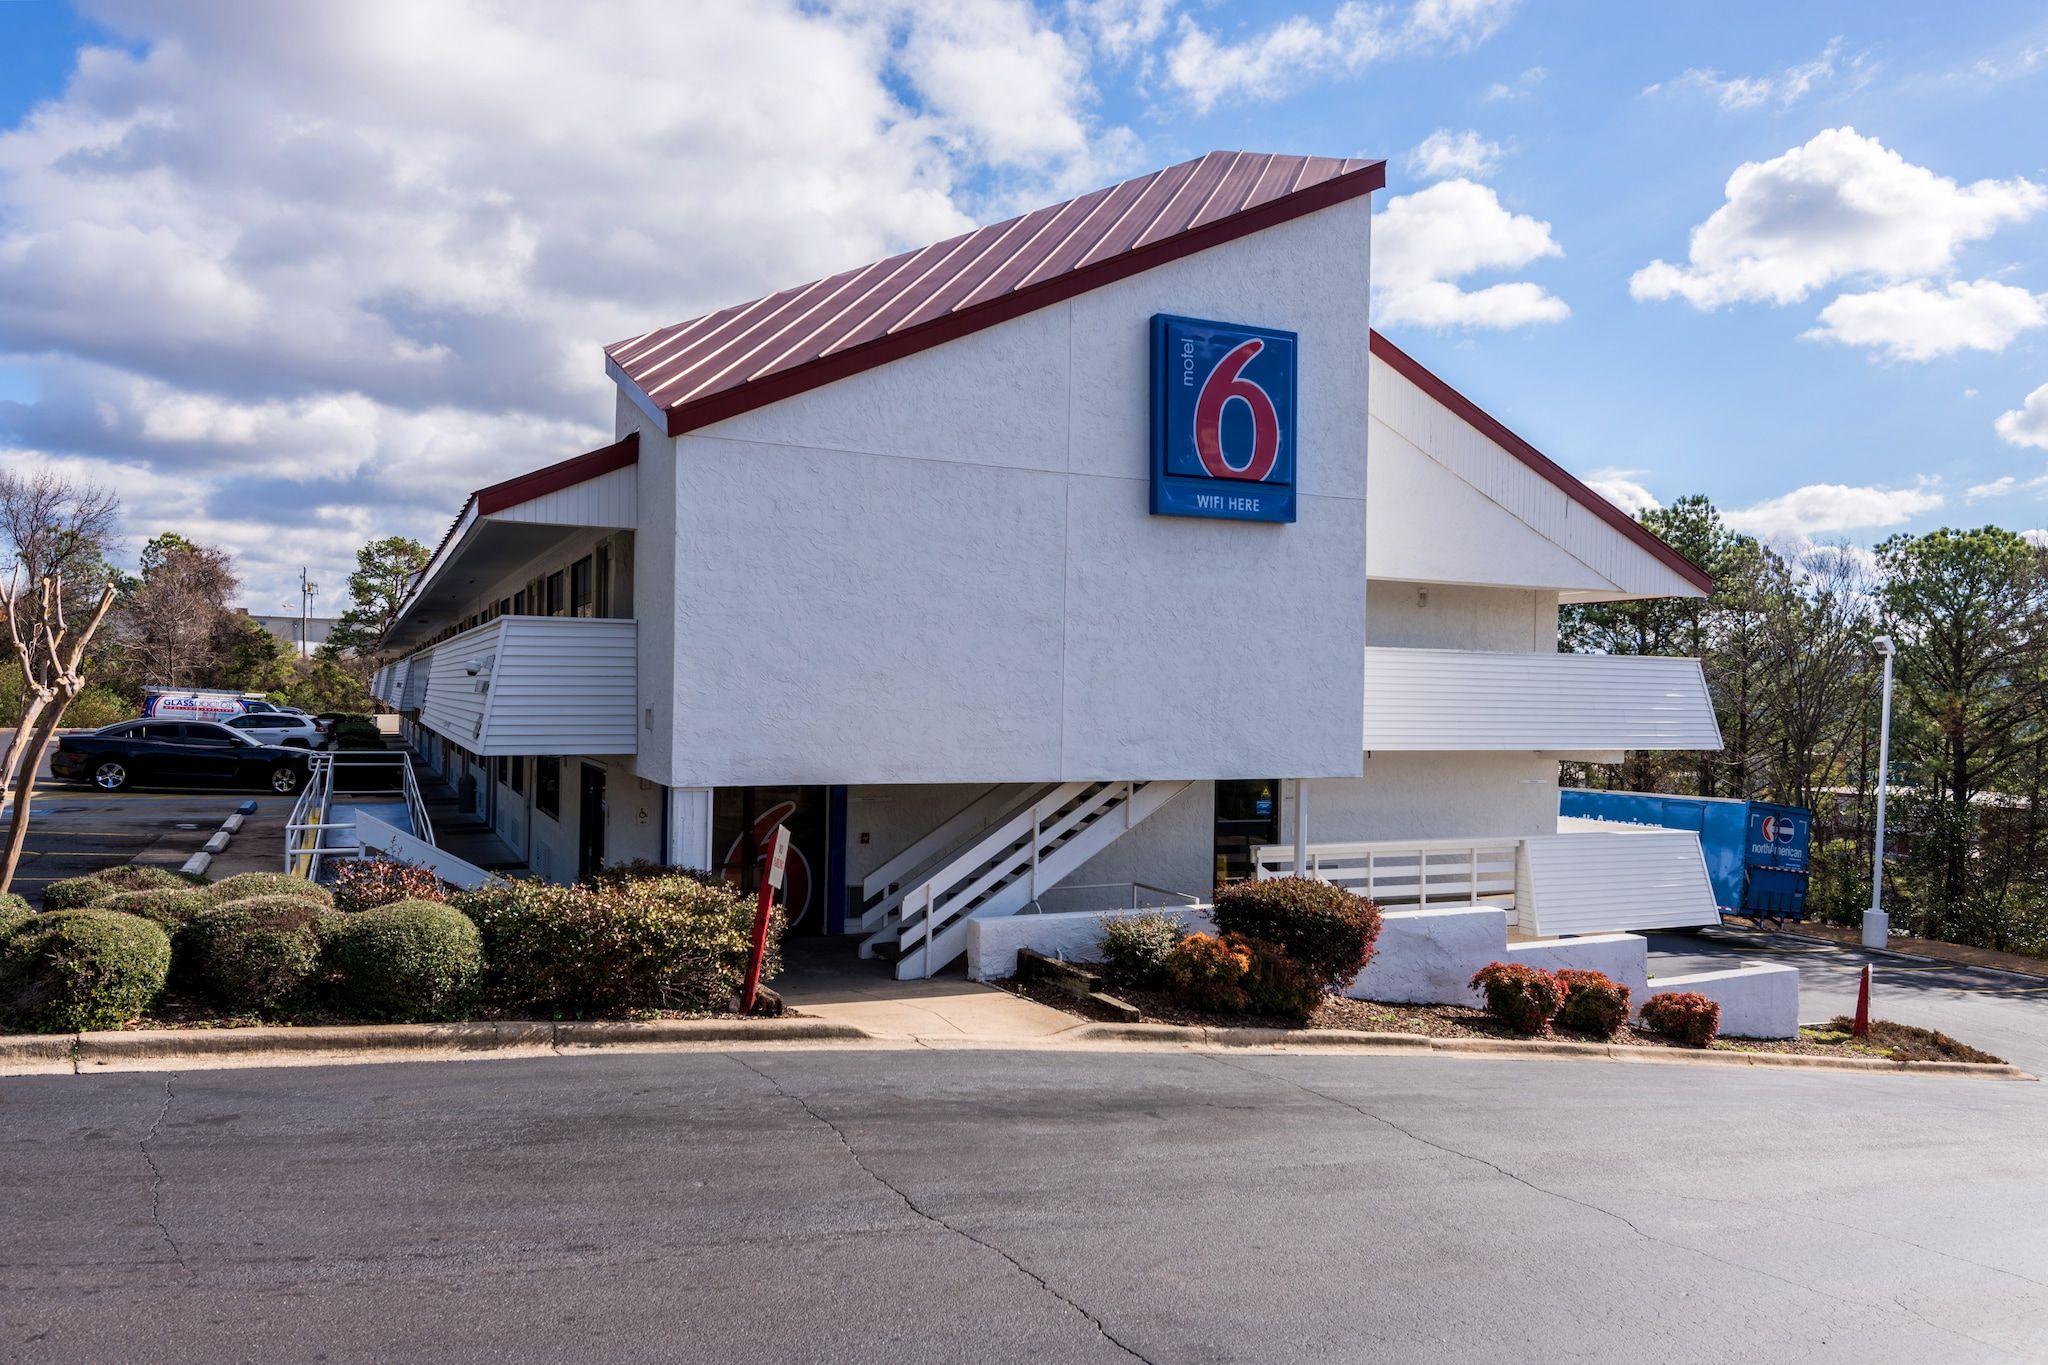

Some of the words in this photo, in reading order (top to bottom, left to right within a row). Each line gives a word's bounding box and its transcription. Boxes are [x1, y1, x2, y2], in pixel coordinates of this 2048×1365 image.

[1181, 338, 1194, 386] motel
[1193, 338, 1279, 481] 6
[1197, 495, 1223, 509] WIFI
[1229, 497, 1259, 511] HERE
